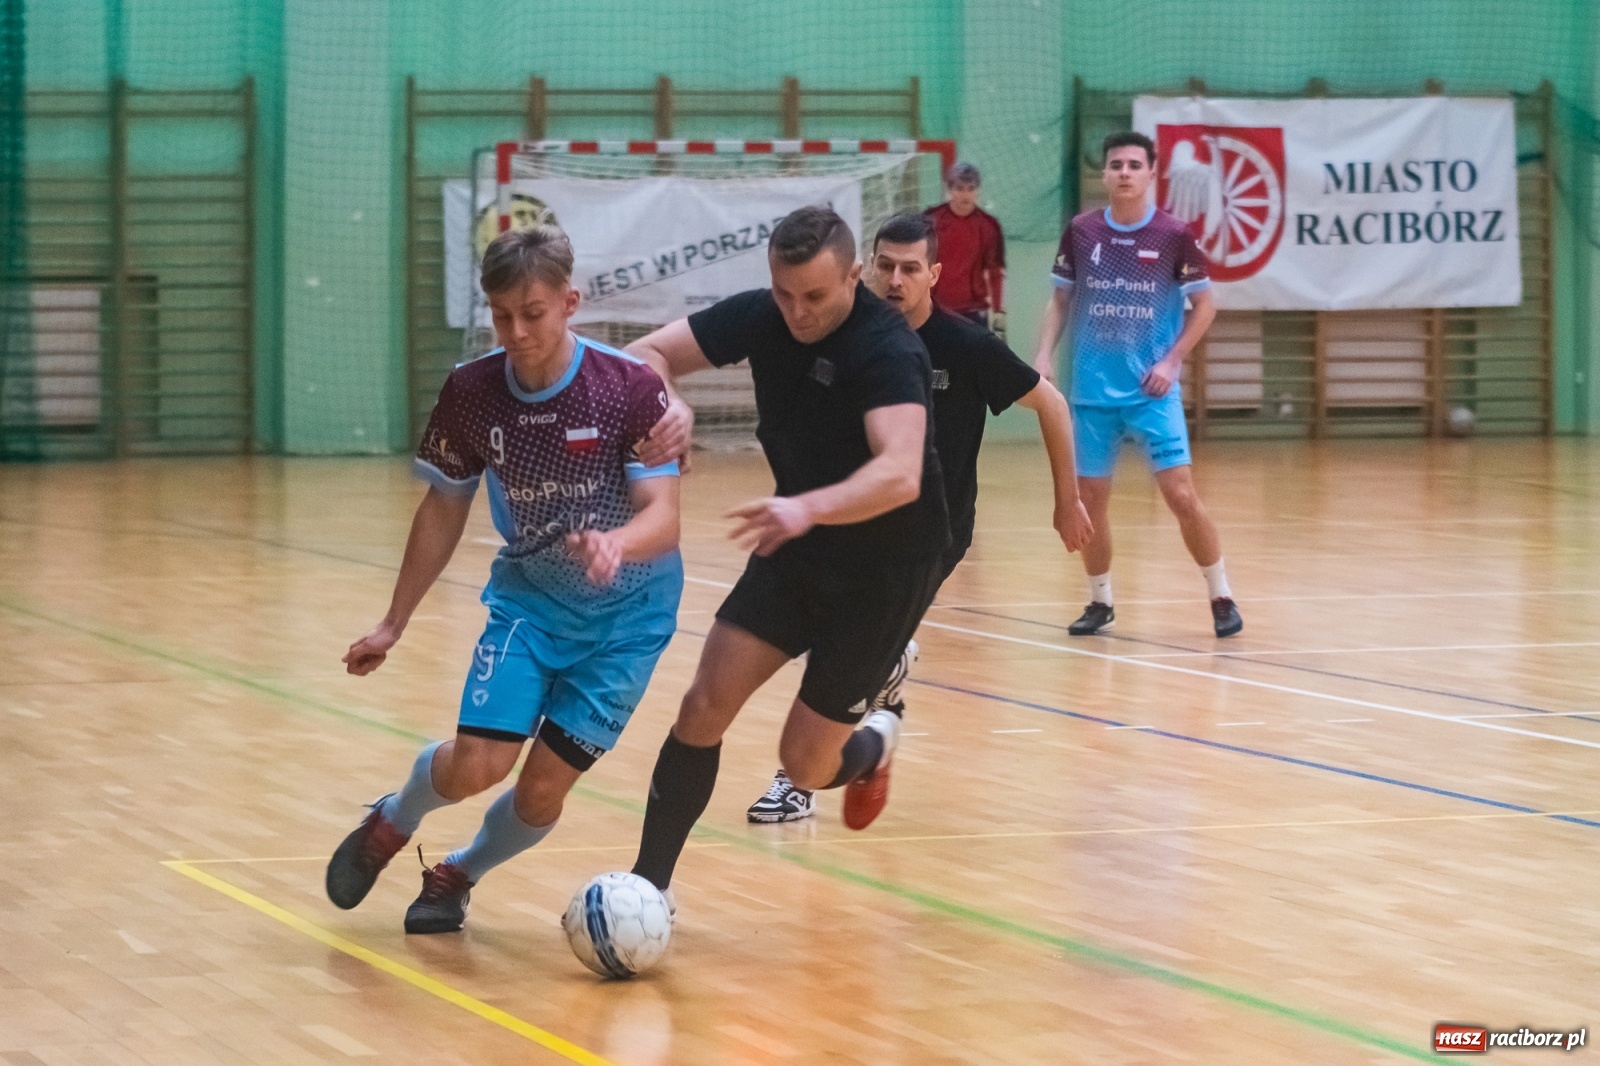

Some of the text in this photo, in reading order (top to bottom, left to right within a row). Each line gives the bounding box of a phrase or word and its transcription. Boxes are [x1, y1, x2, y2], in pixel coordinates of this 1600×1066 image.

[1323, 160, 1477, 195] MIASTO
[1296, 201, 1504, 245] RACIBÓRZ
[583, 216, 787, 301] JEST W PORZA
[1090, 243, 1102, 265] 4
[1086, 276, 1156, 292] Geo-Punkt
[490, 426, 504, 464] 9
[475, 643, 496, 682] 9
